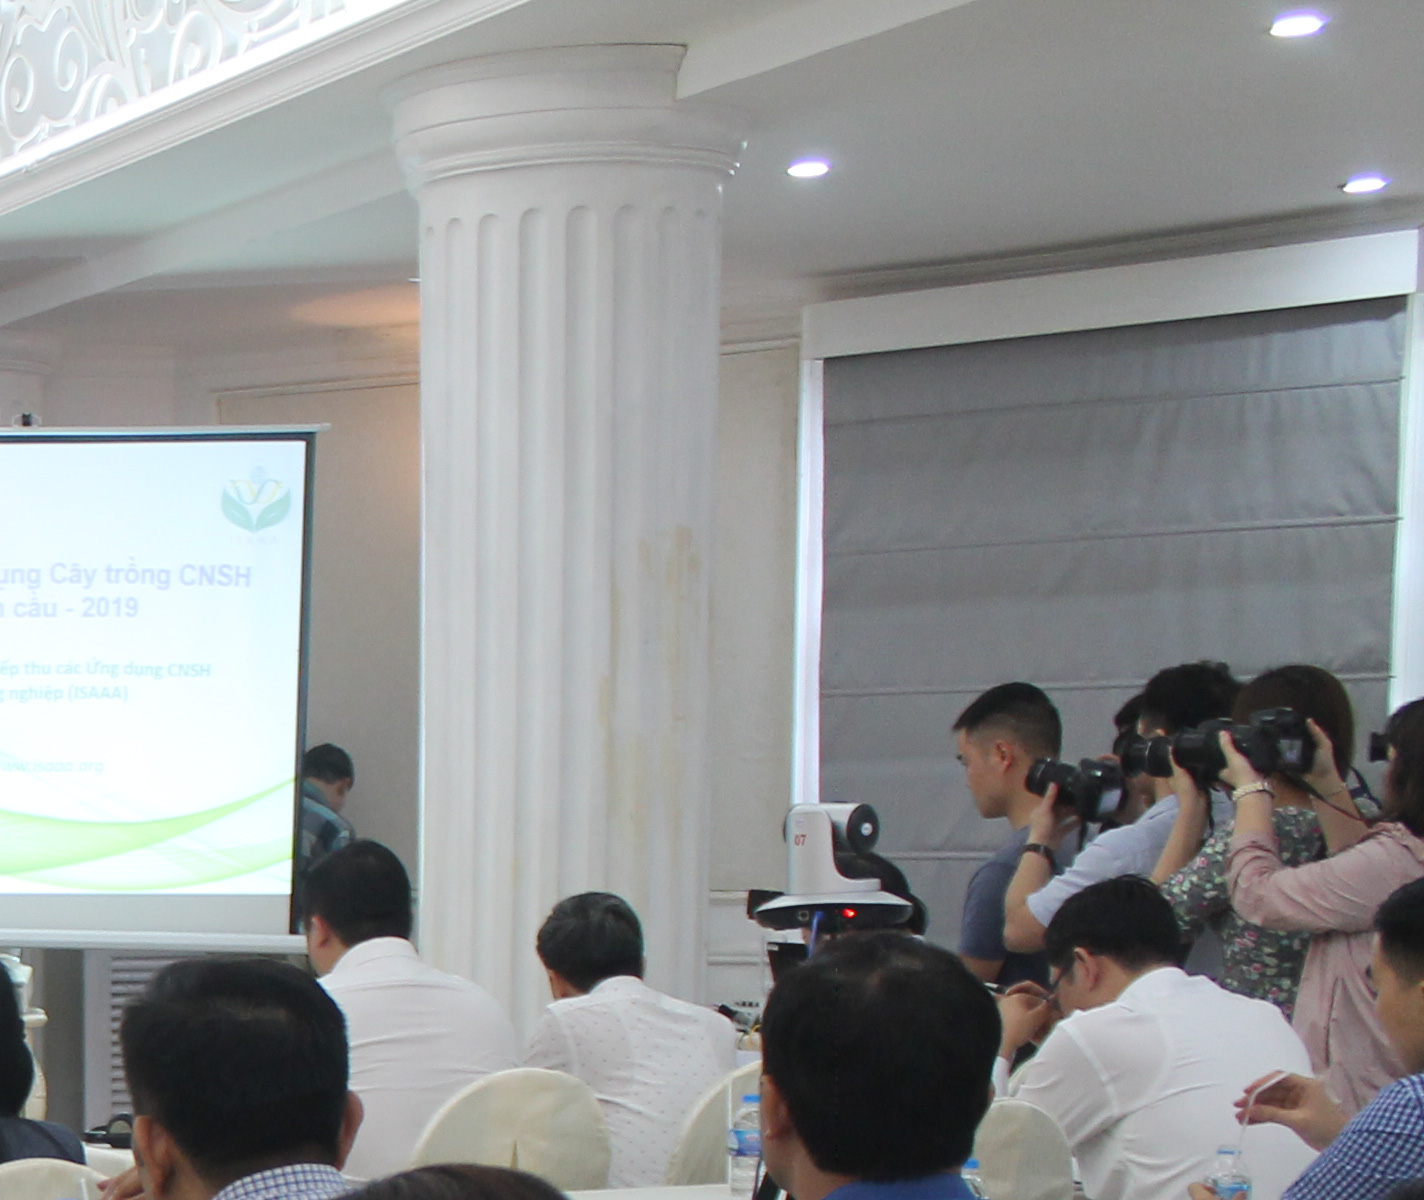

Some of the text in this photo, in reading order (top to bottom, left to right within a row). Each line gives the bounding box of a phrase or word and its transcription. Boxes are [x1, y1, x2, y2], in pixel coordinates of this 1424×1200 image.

[50, 562, 97, 590] Cây
[104, 555, 172, 591] trồng
[178, 563, 252, 588] CNSH
[81, 596, 139, 617] 2019
[24, 662, 53, 675] thu
[167, 663, 212, 677] CNSH
[68, 684, 128, 703] (ISAAA)
[794, 834, 807, 846] 07
